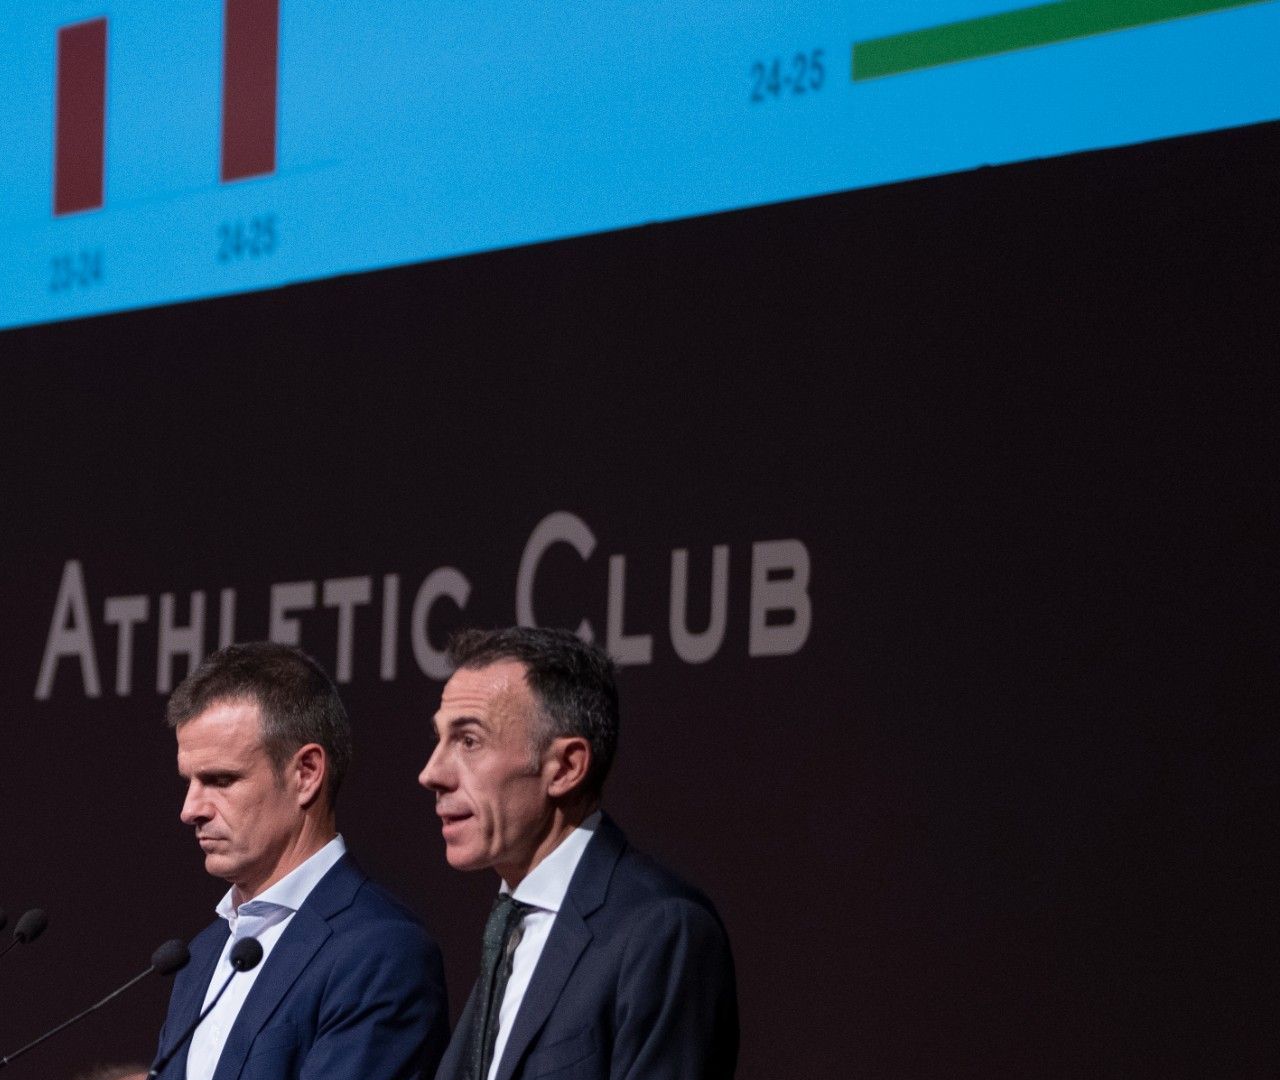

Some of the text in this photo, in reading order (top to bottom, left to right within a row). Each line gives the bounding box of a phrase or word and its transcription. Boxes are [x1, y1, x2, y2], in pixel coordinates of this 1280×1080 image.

[749, 47, 826, 101] 24-25
[215, 213, 278, 265] 24-25
[515, 509, 812, 666] CLUB
